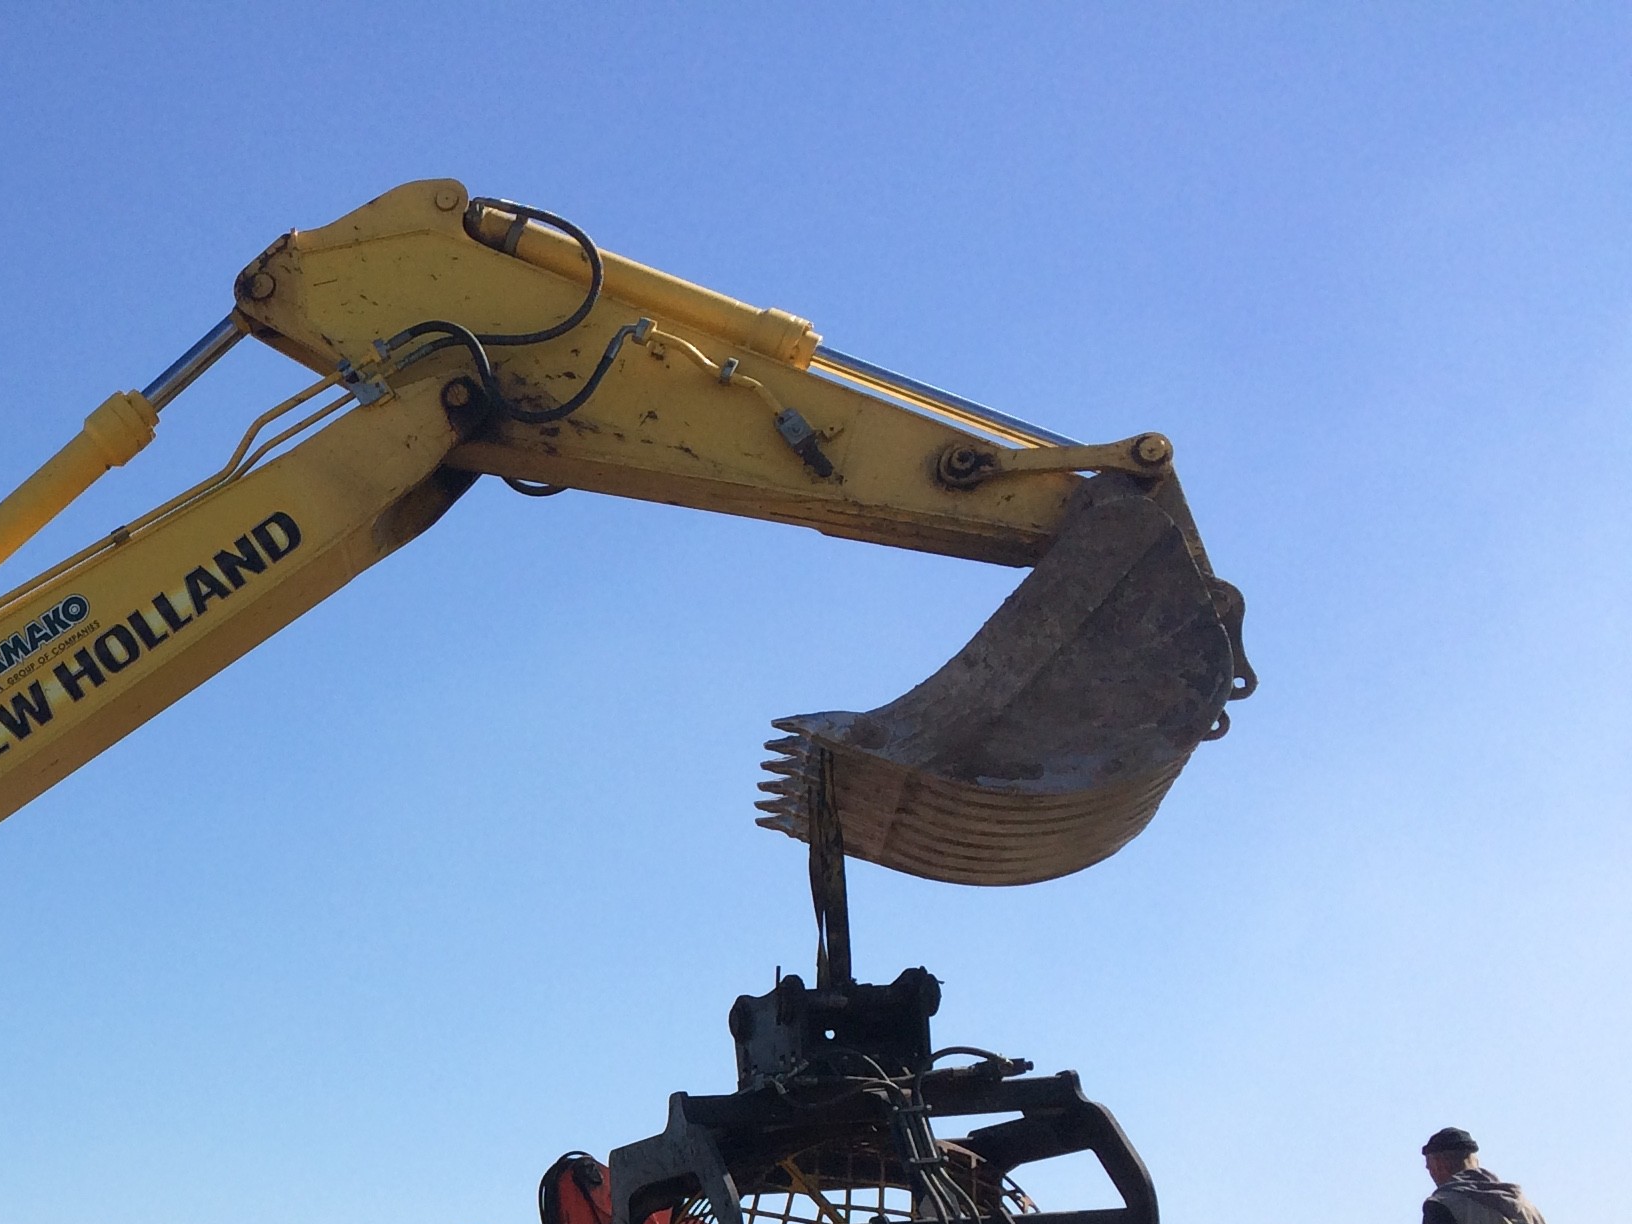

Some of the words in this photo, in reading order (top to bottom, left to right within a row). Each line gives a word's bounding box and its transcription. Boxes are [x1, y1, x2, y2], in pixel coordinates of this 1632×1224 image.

[7, 663, 35, 685] GROUP
[37, 653, 50, 665] OF
[51, 619, 100, 656] COMPANIES
[53, 511, 302, 702] HOLLAND
